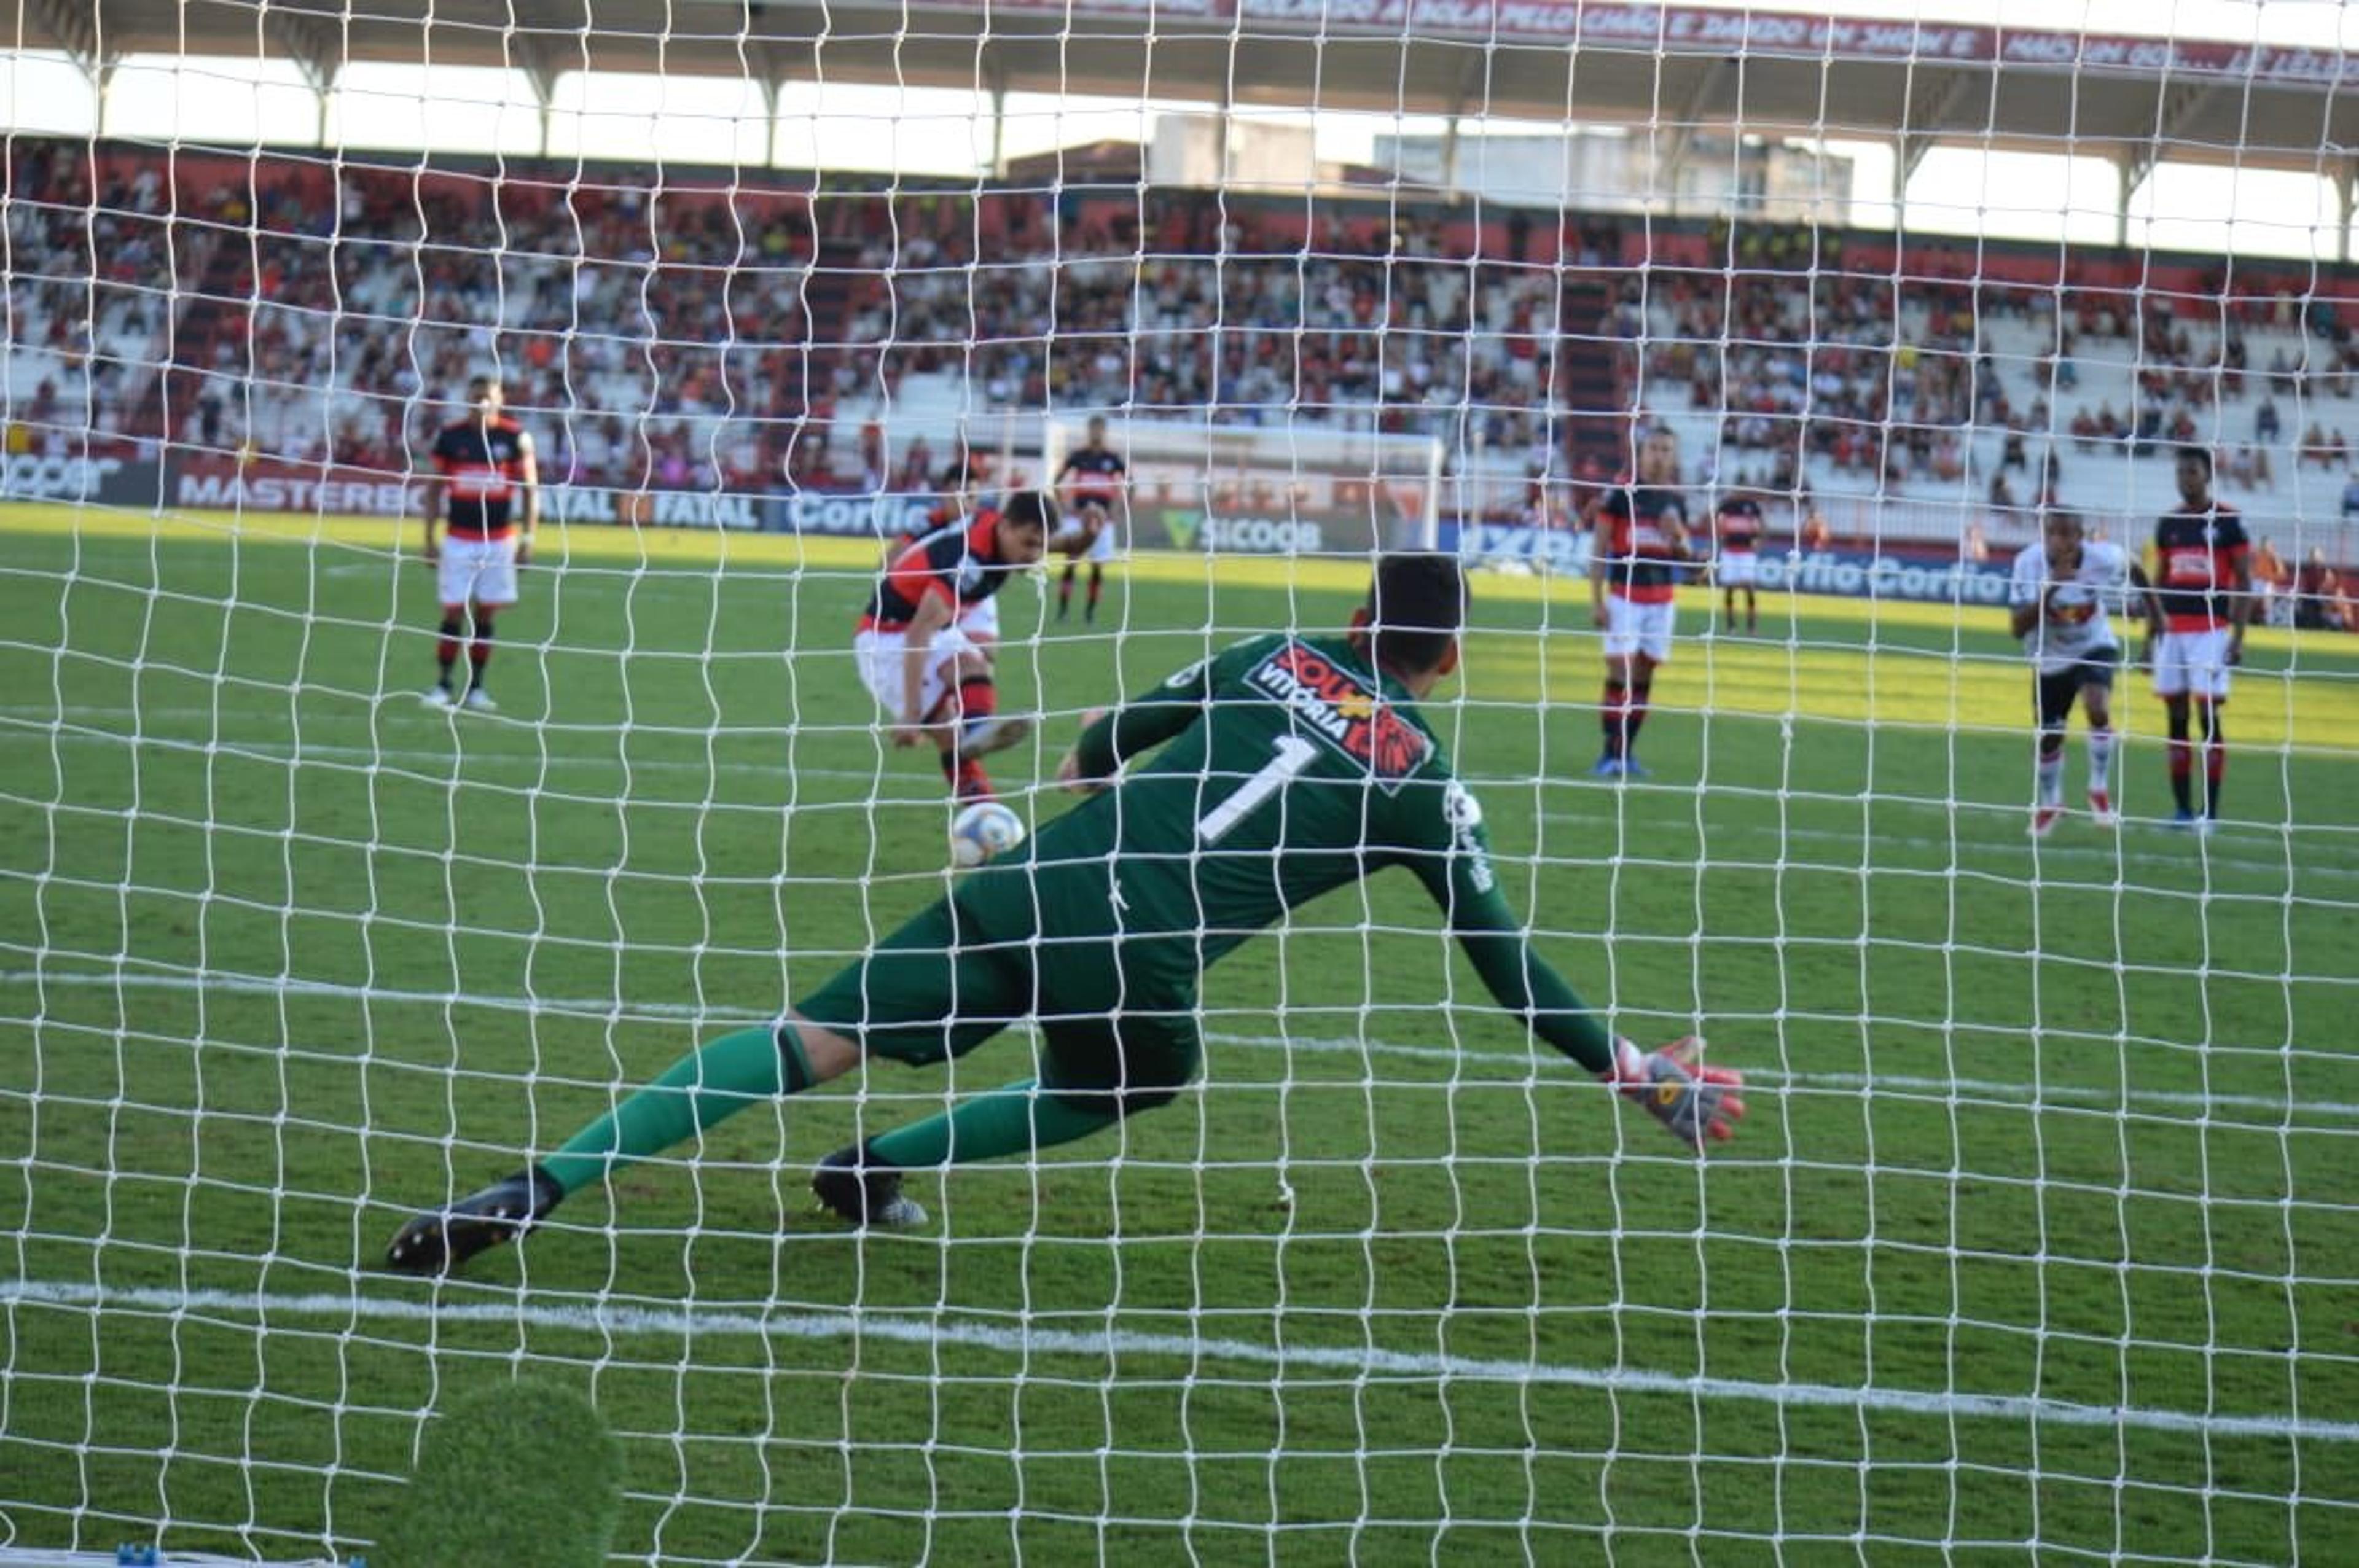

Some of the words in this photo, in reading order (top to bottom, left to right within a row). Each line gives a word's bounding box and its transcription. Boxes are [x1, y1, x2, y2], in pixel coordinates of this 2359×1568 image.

[655, 491, 758, 530] FATAL
[1200, 518, 1320, 550] SICOOB
[1756, 549, 1861, 591] orfio
[1869, 556, 2006, 597] Corfio
[1259, 661, 1350, 740] VITÓRIA
[1199, 735, 1318, 841] 1
